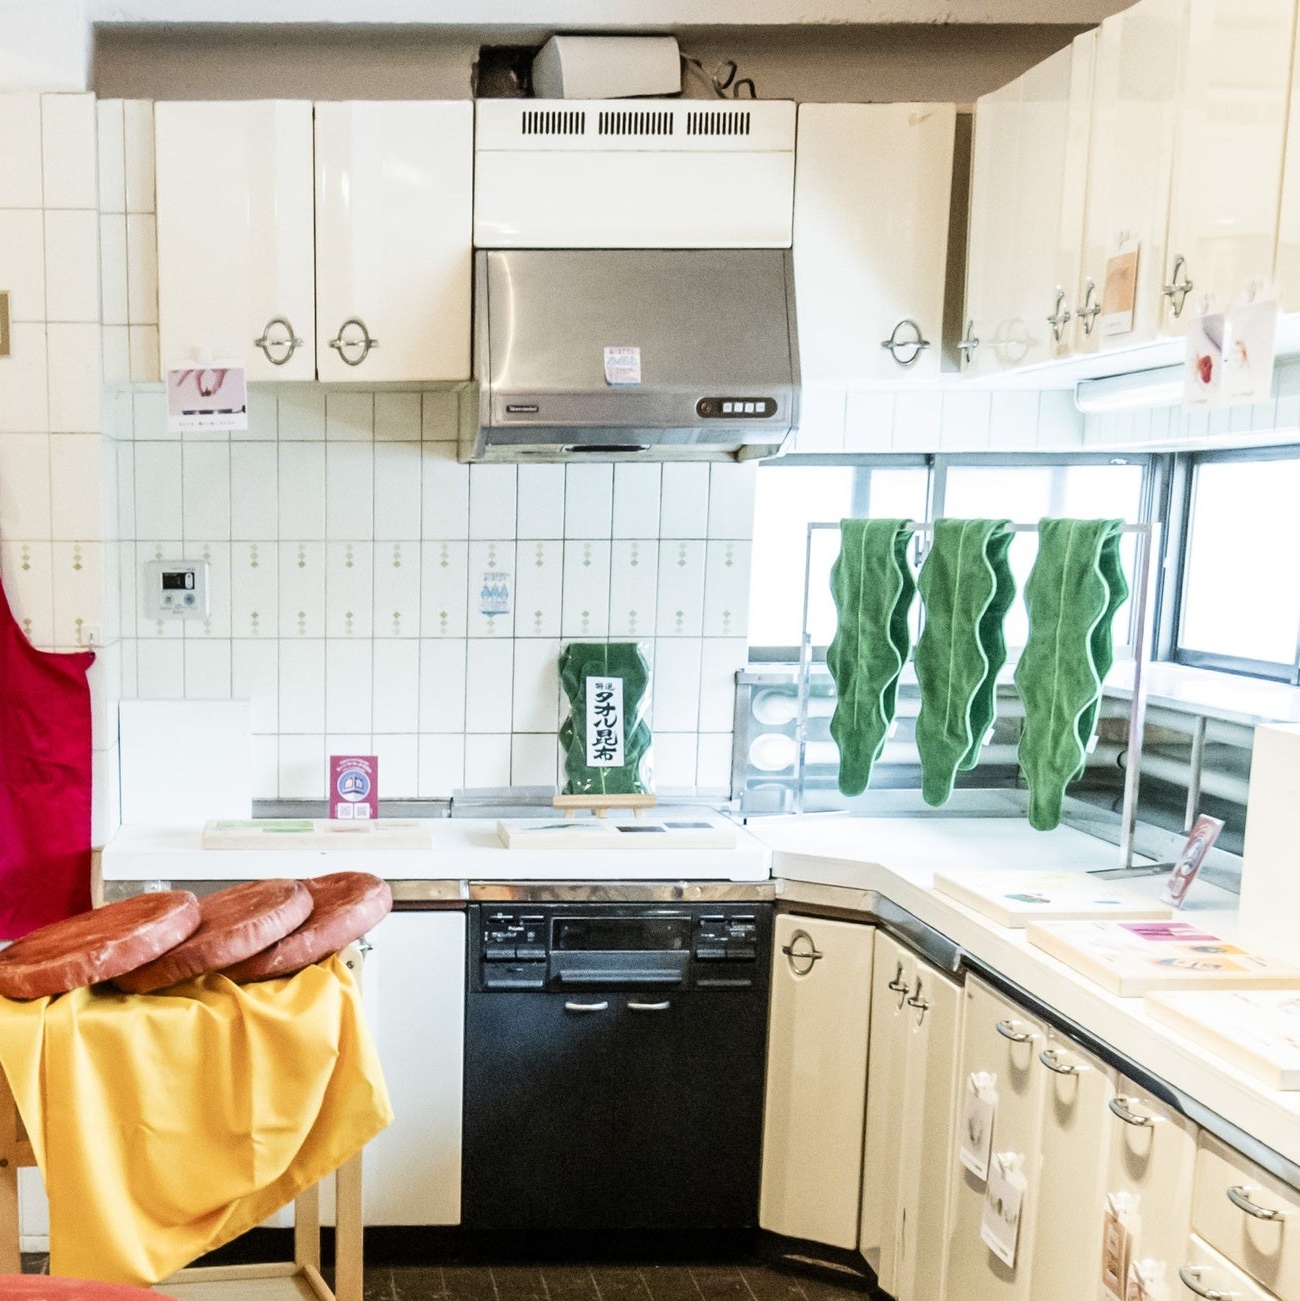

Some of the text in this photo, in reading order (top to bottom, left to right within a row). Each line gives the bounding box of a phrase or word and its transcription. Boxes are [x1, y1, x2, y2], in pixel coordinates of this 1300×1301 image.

[592, 691, 619, 762] タオル昆布
